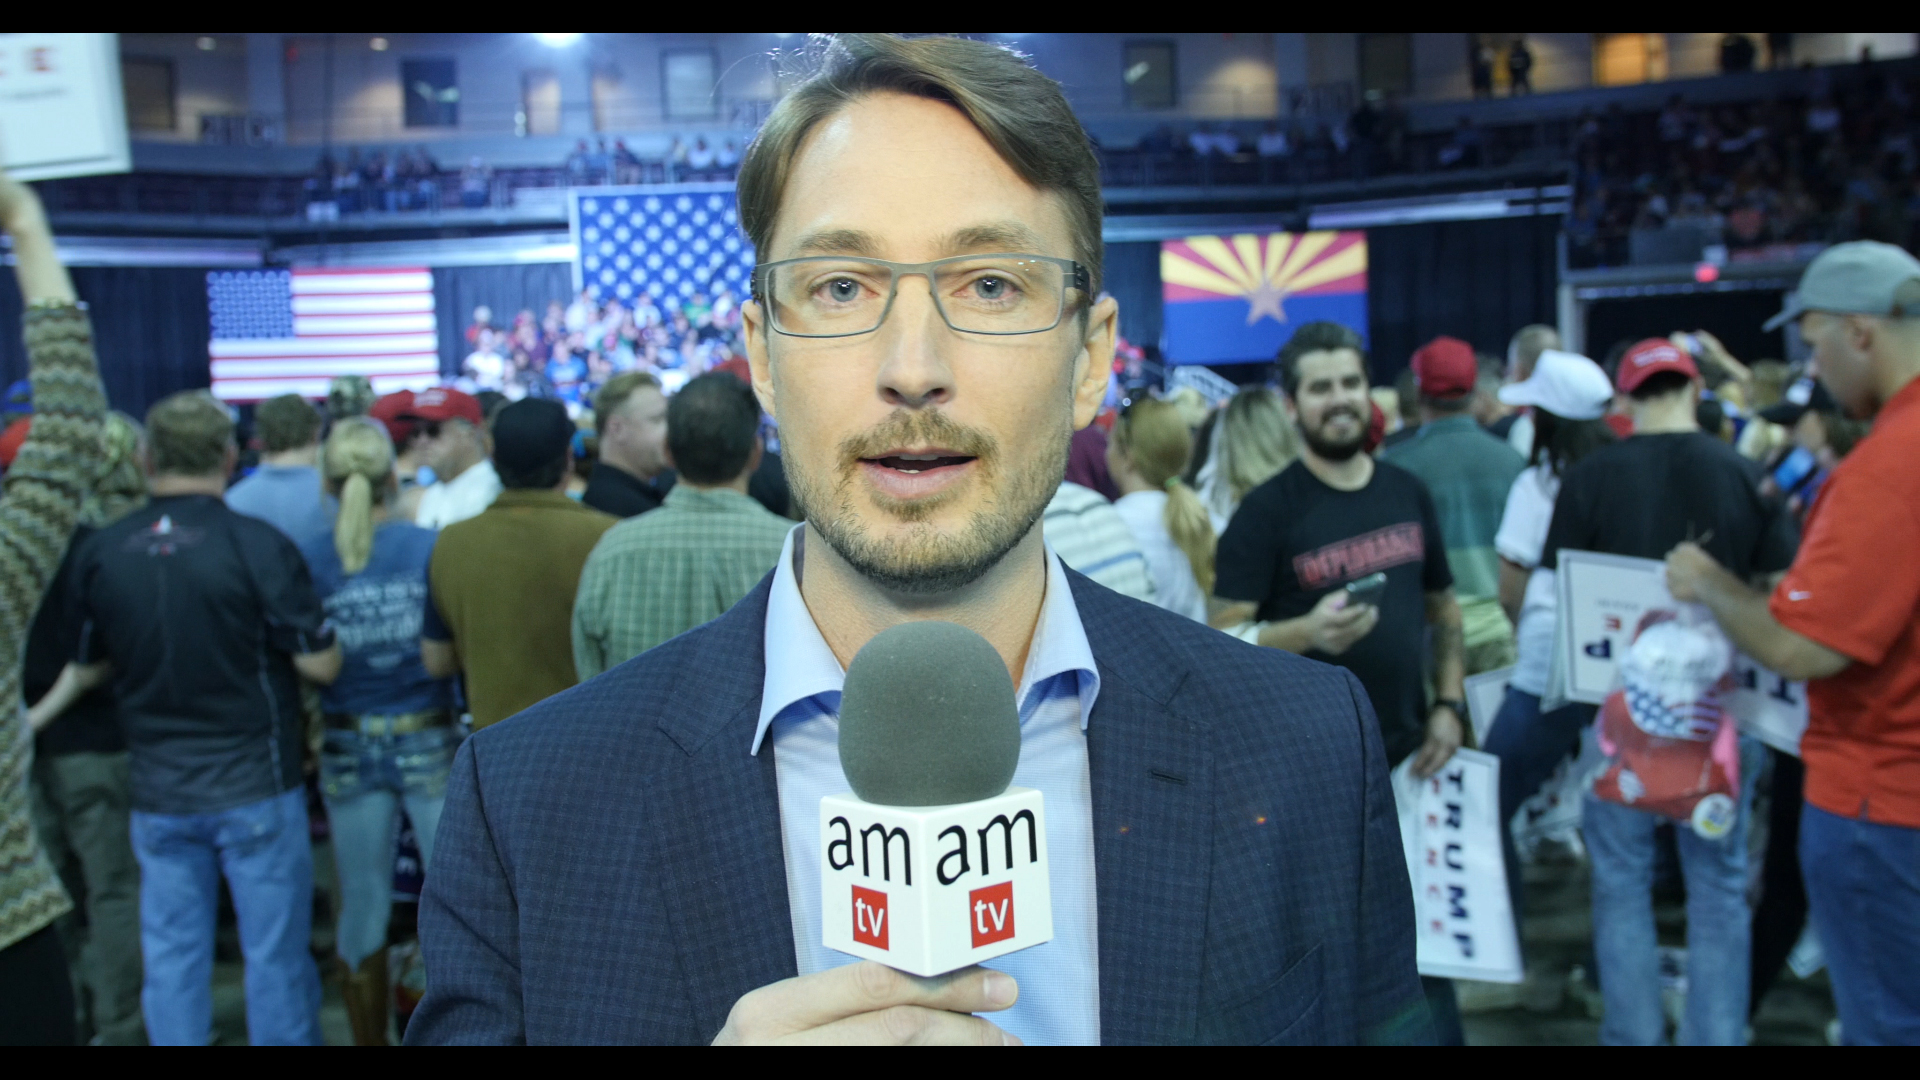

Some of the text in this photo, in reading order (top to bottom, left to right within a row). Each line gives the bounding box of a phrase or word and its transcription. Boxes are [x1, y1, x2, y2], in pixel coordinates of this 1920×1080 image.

[827, 816, 912, 886] am
[936, 809, 1038, 886] am
[1446, 770, 1475, 958] TRUMP
[855, 897, 885, 938] tv
[974, 898, 1009, 934] tv
